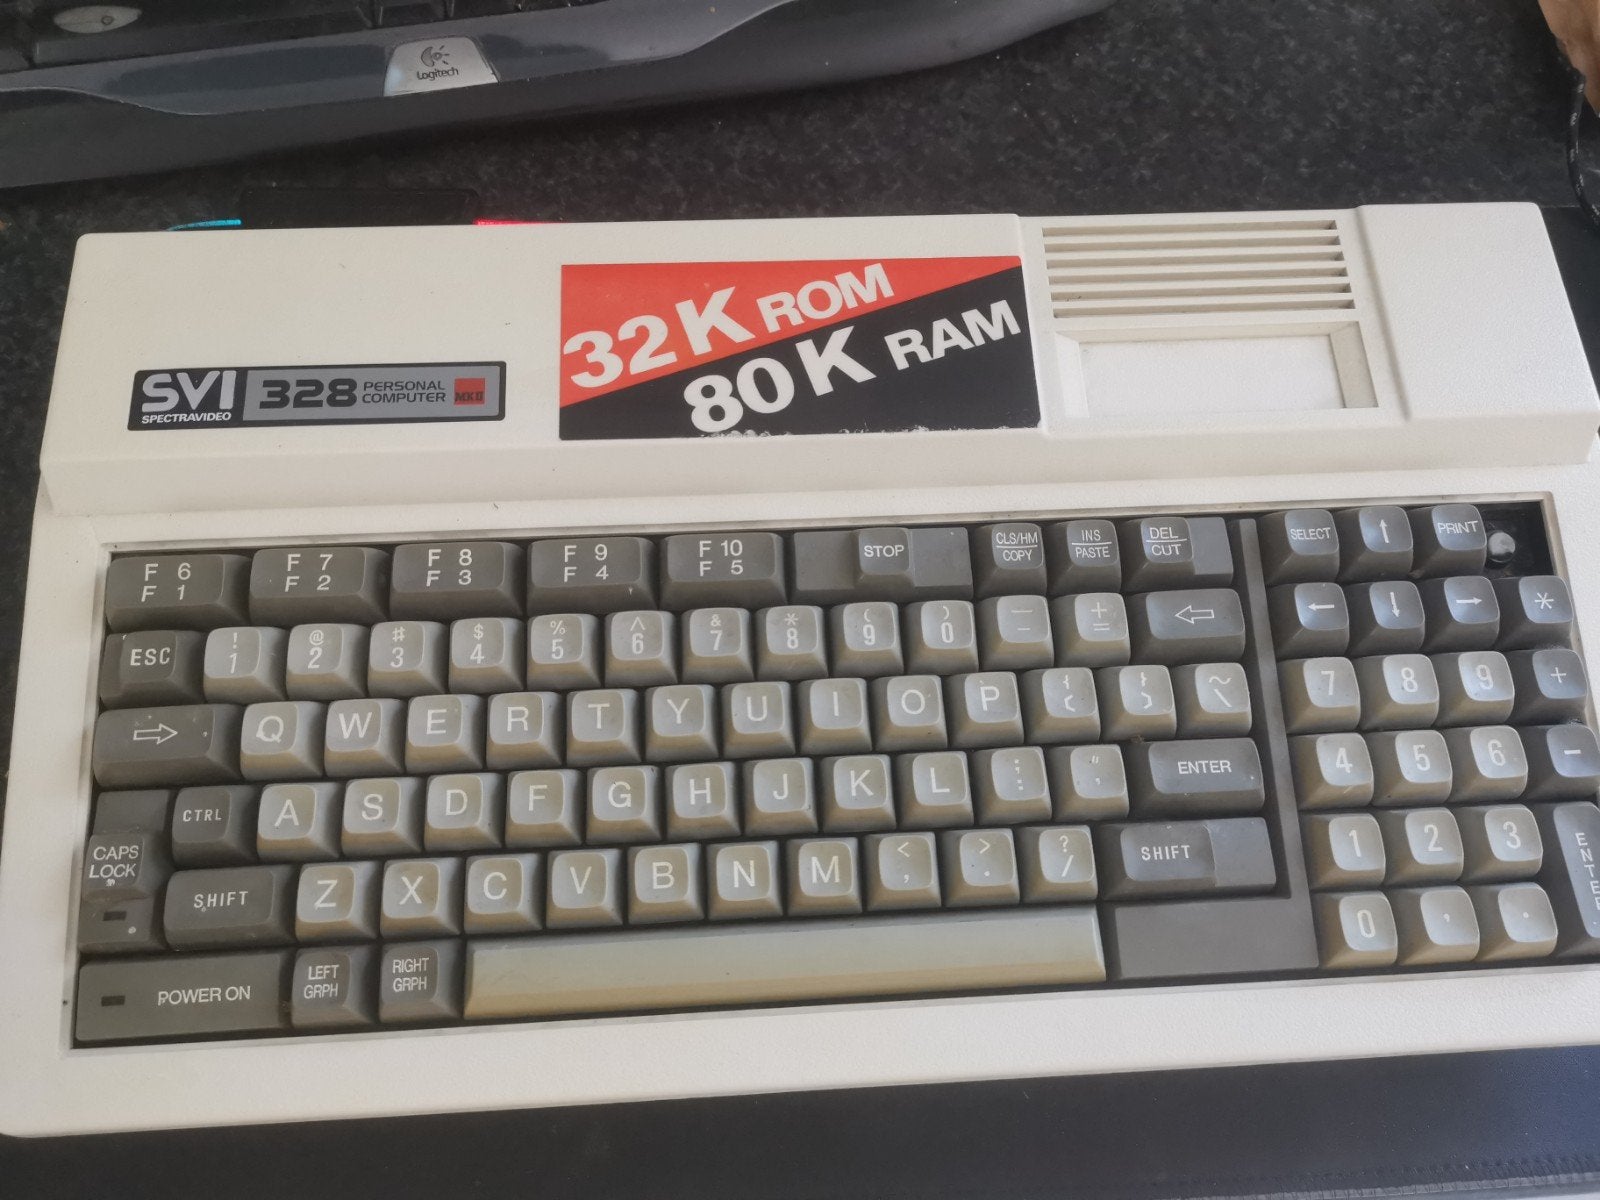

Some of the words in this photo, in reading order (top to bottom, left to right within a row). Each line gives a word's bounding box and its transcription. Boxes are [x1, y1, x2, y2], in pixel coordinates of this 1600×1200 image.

[417, 67, 458, 80] Logitech
[756, 263, 895, 333] ROM
[884, 300, 1021, 370] RAM
[141, 370, 236, 412] SVI
[260, 379, 357, 409] 328
[364, 381, 444, 391] PERSONAL
[362, 393, 445, 403] COMPUTER
[141, 412, 231, 424] SPECTRAVIDEO
[996, 532, 1037, 544] CLS/HM
[1082, 530, 1100, 541] INS
[1150, 527, 1178, 539] DEL
[1290, 528, 1330, 540] SELECT
[1437, 520, 1477, 535] PRINT
[429, 549, 441, 566] F
[459, 549, 472, 566] 8
[565, 545, 576, 562] F
[595, 544, 607, 560] 9
[700, 541, 711, 557] F
[721, 540, 742, 556] 10
[864, 545, 904, 557] STOP
[1003, 550, 1032, 561] COPY
[1076, 547, 1109, 558] PASTE
[1152, 544, 1180, 555] CUT
[145, 564, 158, 581] F
[178, 563, 190, 580] 6
[288, 554, 300, 571] F
[320, 554, 332, 570] 7
[700, 561, 712, 576] F
[731, 560, 743, 574] 5
[285, 576, 299, 591] F
[317, 575, 330, 590] 2
[427, 571, 440, 586] F
[459, 570, 471, 585] 3
[564, 567, 576, 582] F
[596, 565, 609, 580] 4
[142, 586, 156, 601] F
[178, 585, 184, 600] 1
[710, 630, 722, 650] 7
[787, 628, 798, 649] 8
[863, 624, 875, 645] 9
[941, 622, 953, 643] 0
[470, 644, 484, 663] 4
[552, 639, 563, 659] 5
[632, 633, 643, 654] 6
[130, 648, 170, 666] ESC
[230, 653, 237, 673] 1
[308, 647, 322, 668] 2
[390, 647, 403, 667] 3
[1321, 671, 1334, 695] 7
[1401, 668, 1417, 692] 8
[1475, 665, 1493, 690] 9
[747, 696, 767, 721] U
[833, 692, 839, 716] I
[901, 690, 925, 714] O
[980, 686, 999, 711] P
[427, 709, 446, 734] E
[507, 707, 528, 731] R
[588, 704, 609, 729] T
[667, 699, 689, 724] Y
[256, 716, 283, 742] Q
[339, 712, 372, 739] W
[1336, 748, 1352, 773] 4
[1413, 745, 1430, 771] 5
[1488, 740, 1505, 766] 6
[1178, 760, 1231, 774] ENTER
[690, 778, 711, 804] H
[773, 774, 788, 799] J
[851, 770, 873, 796] K
[930, 768, 949, 793] L
[446, 790, 467, 815] D
[529, 785, 547, 811] F
[608, 782, 631, 807] G
[183, 809, 221, 822] CTRL
[275, 800, 299, 826] A
[362, 794, 382, 820] S
[1349, 830, 1361, 857] 1
[1424, 825, 1443, 851] 2
[1503, 822, 1521, 849] 3
[94, 846, 138, 860] CAPS
[1141, 845, 1189, 860] SHIFT
[89, 864, 136, 878] LOCK
[653, 862, 674, 889] B
[734, 861, 755, 887] N
[812, 856, 839, 883] M
[399, 877, 423, 905] X
[484, 872, 506, 899] C
[570, 867, 591, 894] V
[194, 891, 248, 908] SHIFT
[314, 880, 337, 909] Z
[1357, 910, 1375, 938] 0
[308, 965, 339, 980] LEFT
[393, 958, 429, 973] RIGHT
[304, 984, 338, 999] GRPH
[393, 977, 426, 992] GRPH
[158, 988, 221, 1005] POWER
[226, 986, 250, 1000] ON
